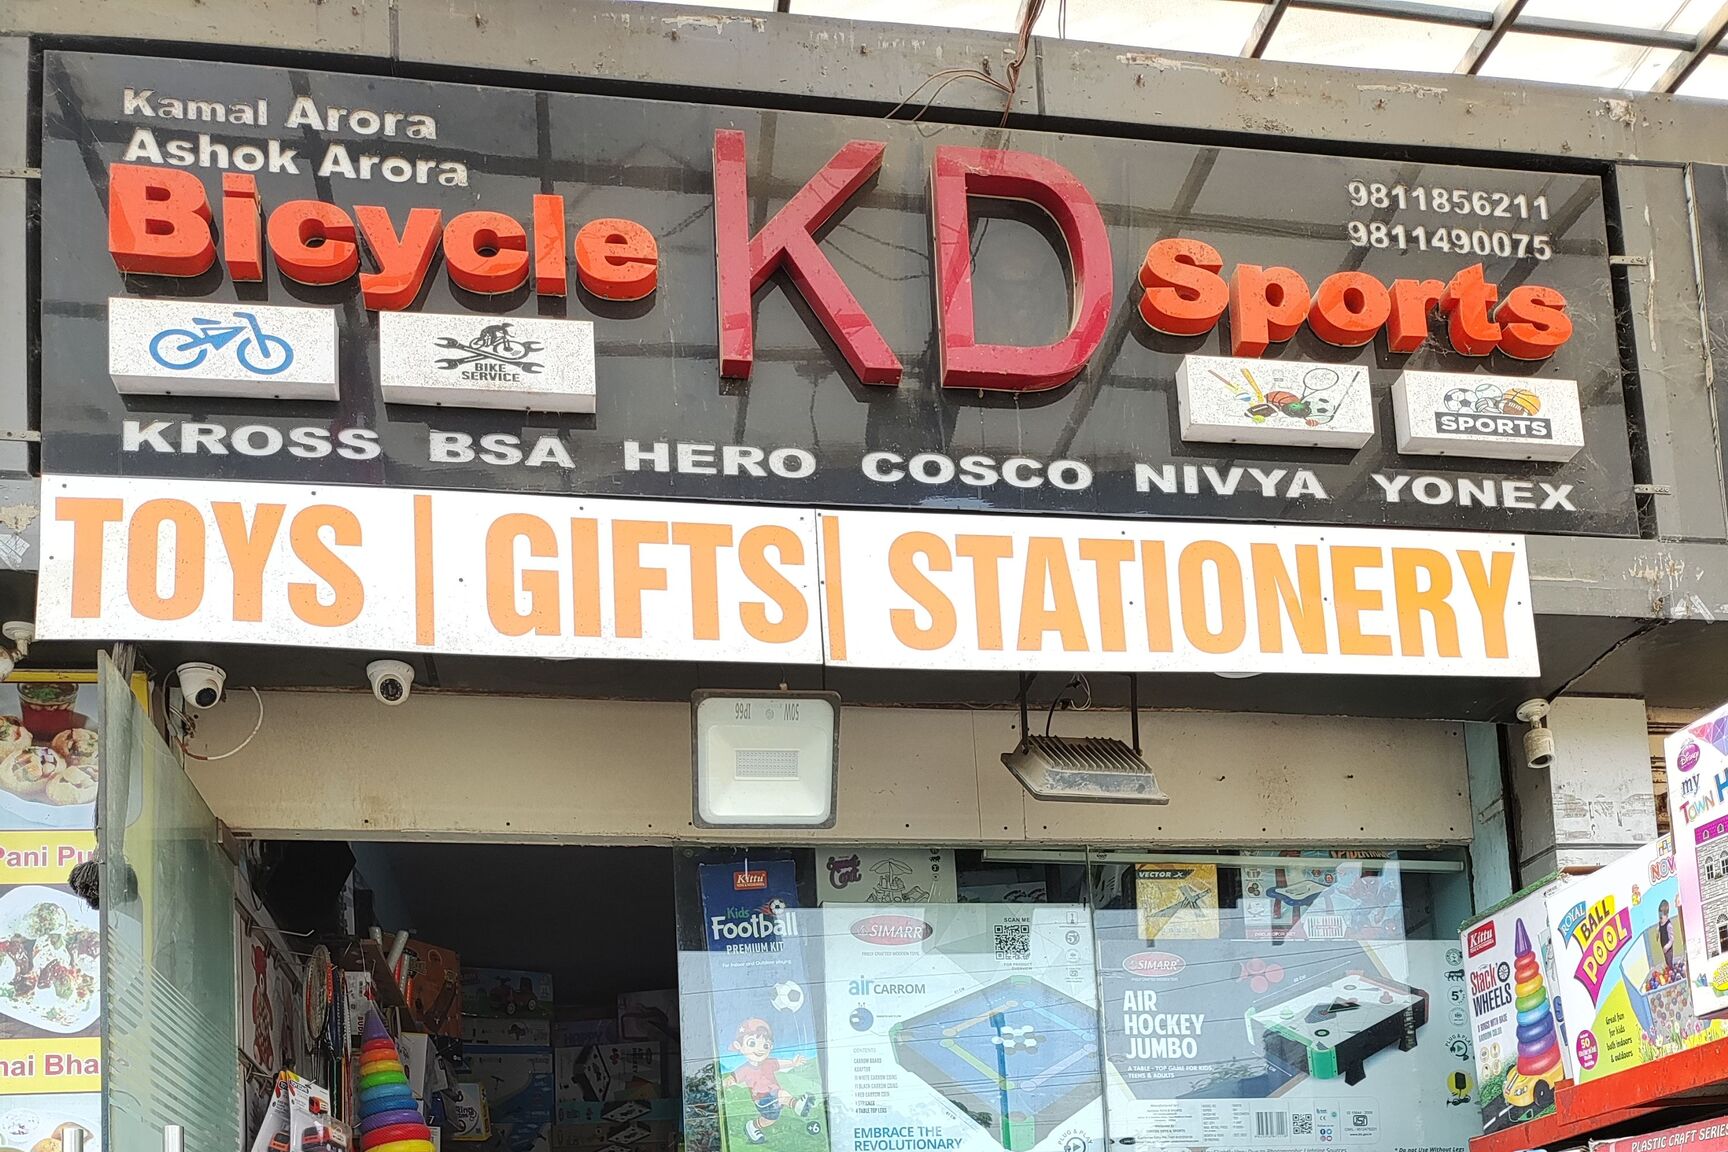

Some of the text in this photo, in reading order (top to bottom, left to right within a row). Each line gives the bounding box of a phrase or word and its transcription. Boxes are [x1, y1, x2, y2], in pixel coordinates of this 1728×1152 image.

[123, 88, 438, 140] Kamal Arora
[123, 129, 469, 188] Ashok Arora
[1347, 180, 1550, 220] 9811856211
[108, 163, 659, 311] Bicycle
[1347, 220, 1553, 261] 9811490075
[713, 129, 1114, 393] KD
[1138, 238, 1574, 361] Sports
[461, 371, 520, 383] SERVICE
[474, 363, 507, 374] BIKE
[1440, 415, 1549, 437] SPORTS
[122, 420, 1577, 512] KROSS BSA HERO COSCO NIVYA YONEX
[55, 497, 1515, 659] TOYS GIFTS STATIONERY
[735, 702, 751, 720] IP66
[1679, 751, 1700, 767] Disney
[1680, 773, 1701, 799] my
[1138, 871, 1172, 879] VECTOR
[726, 906, 750, 919] Kids
[1561, 901, 1587, 934] ROYAL
[1580, 898, 1611, 942] BALL
[710, 911, 799, 940] Football
[868, 923, 923, 940] SIMARR
[726, 941, 784, 955] PREMIUM KIT
[1470, 927, 1494, 948] Kittu
[1582, 912, 1628, 985] POOL
[1137, 959, 1178, 971] SIMARR
[848, 975, 926, 996] air CARROM
[1123, 989, 1158, 1012] AIR
[1472, 982, 1513, 1018] WHEELS
[1123, 1013, 1205, 1036] HOCKEY
[1617, 1012, 1625, 1021] fun
[1608, 1024, 1626, 1038] for kids
[1126, 1037, 1198, 1059] JUMBO
[1580, 1037, 1591, 1047] 50
[1616, 1036, 1633, 1048] indoors
[1615, 1050, 1634, 1062] outdoors
[853, 1126, 942, 1139] EMBRACE THE
[1669, 1130, 1697, 1147] CRAFT
[854, 1138, 962, 1151] REVOLUTIONARY
